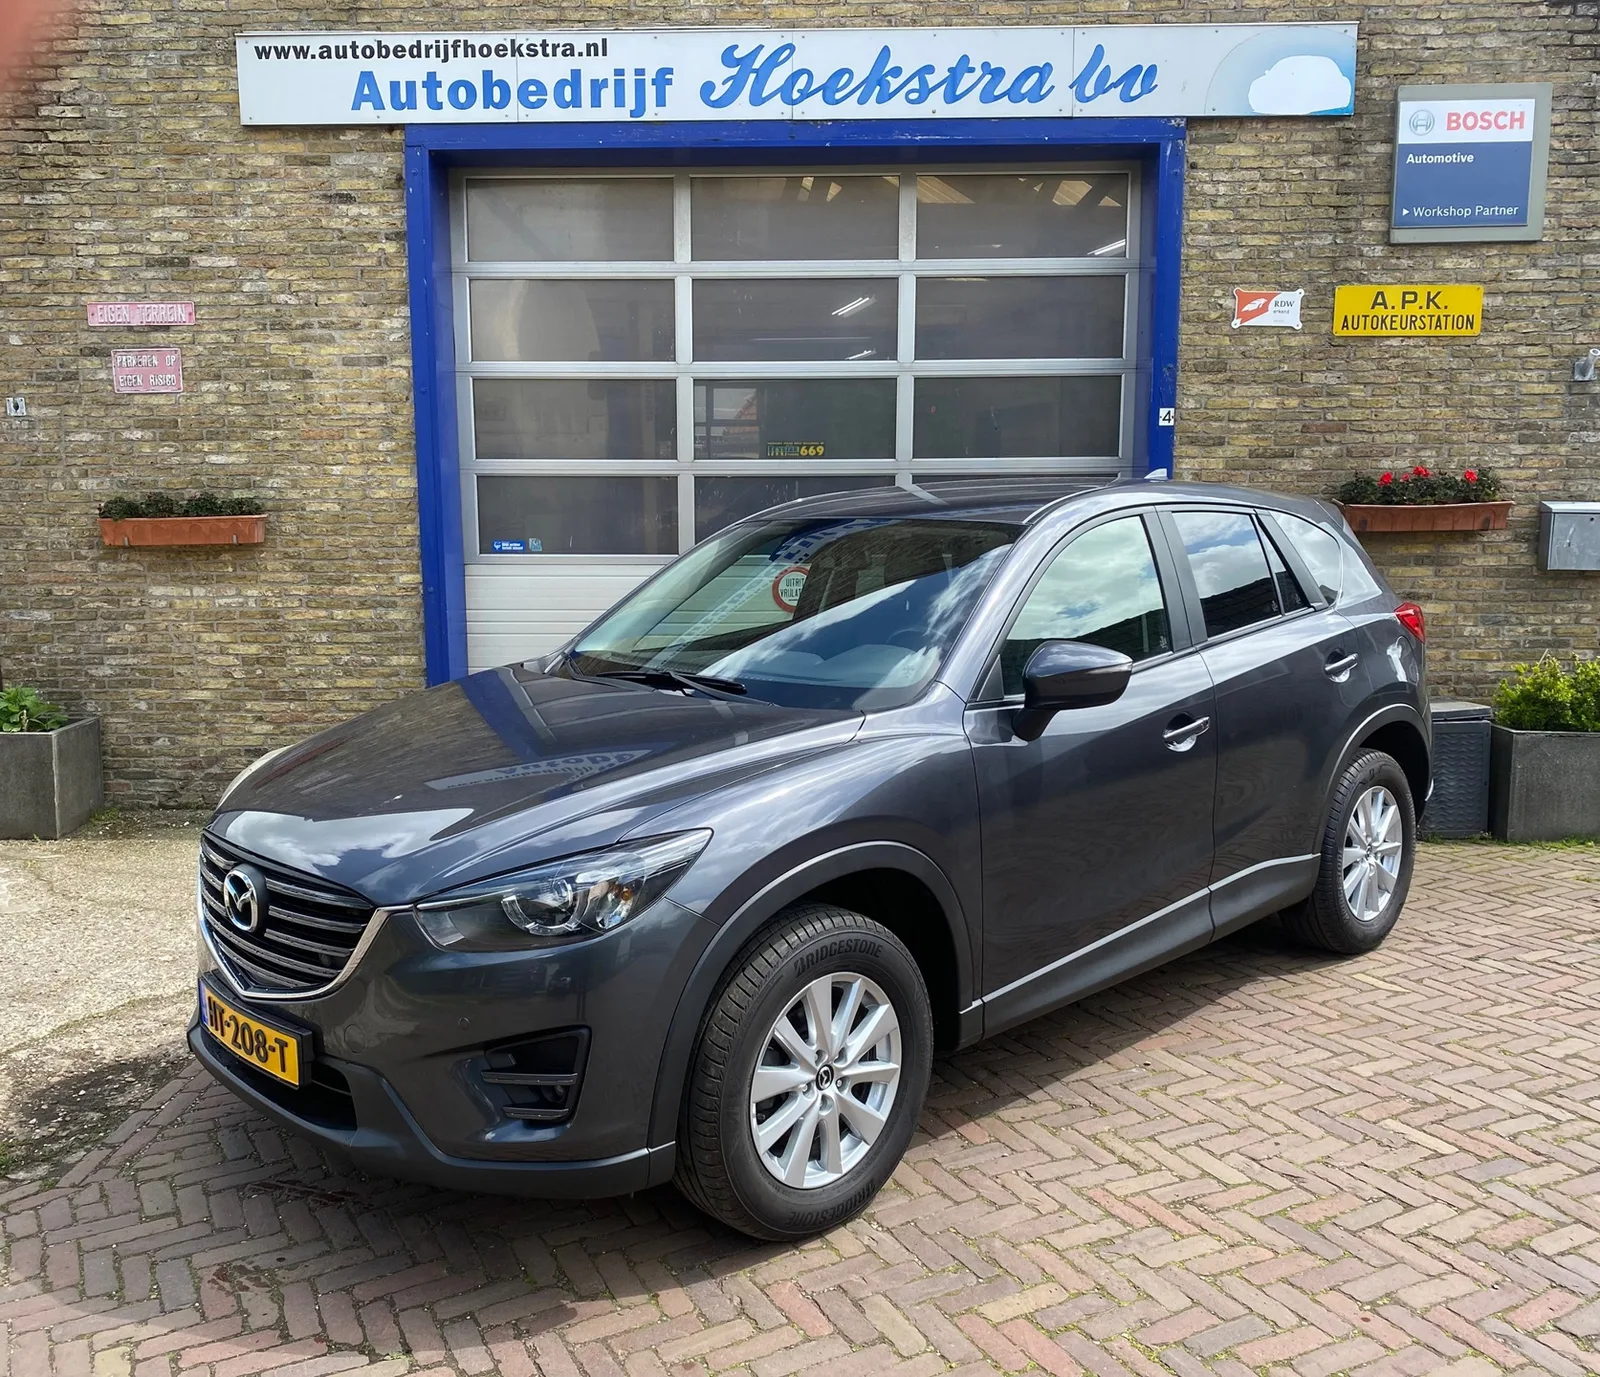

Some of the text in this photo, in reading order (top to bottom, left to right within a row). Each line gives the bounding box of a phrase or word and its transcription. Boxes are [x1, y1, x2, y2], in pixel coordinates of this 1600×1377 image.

[254, 38, 608, 63] www.autobedrijfhoekstra.nl
[351, 43, 1159, 118] Autobedrijf Hoekstra bv
[1446, 111, 1525, 131] BOSCH
[1405, 152, 1475, 164] Automotive
[1413, 205, 1520, 218] Workshop Partner
[1273, 300, 1295, 308] RDW
[1370, 291, 1449, 310] A.P.K.
[97, 304, 187, 323] EIGEN TERREIN
[1341, 314, 1475, 331] AUTOKEURSTATION
[117, 355, 176, 368] PARKEREN OP
[119, 374, 177, 387] EIGEN RISICO
[1162, 410, 1171, 423] 4
[801, 446, 824, 456] 669
[793, 938, 884, 977] BRIDGESTONE
[207, 996, 289, 1073] HT-208-T
